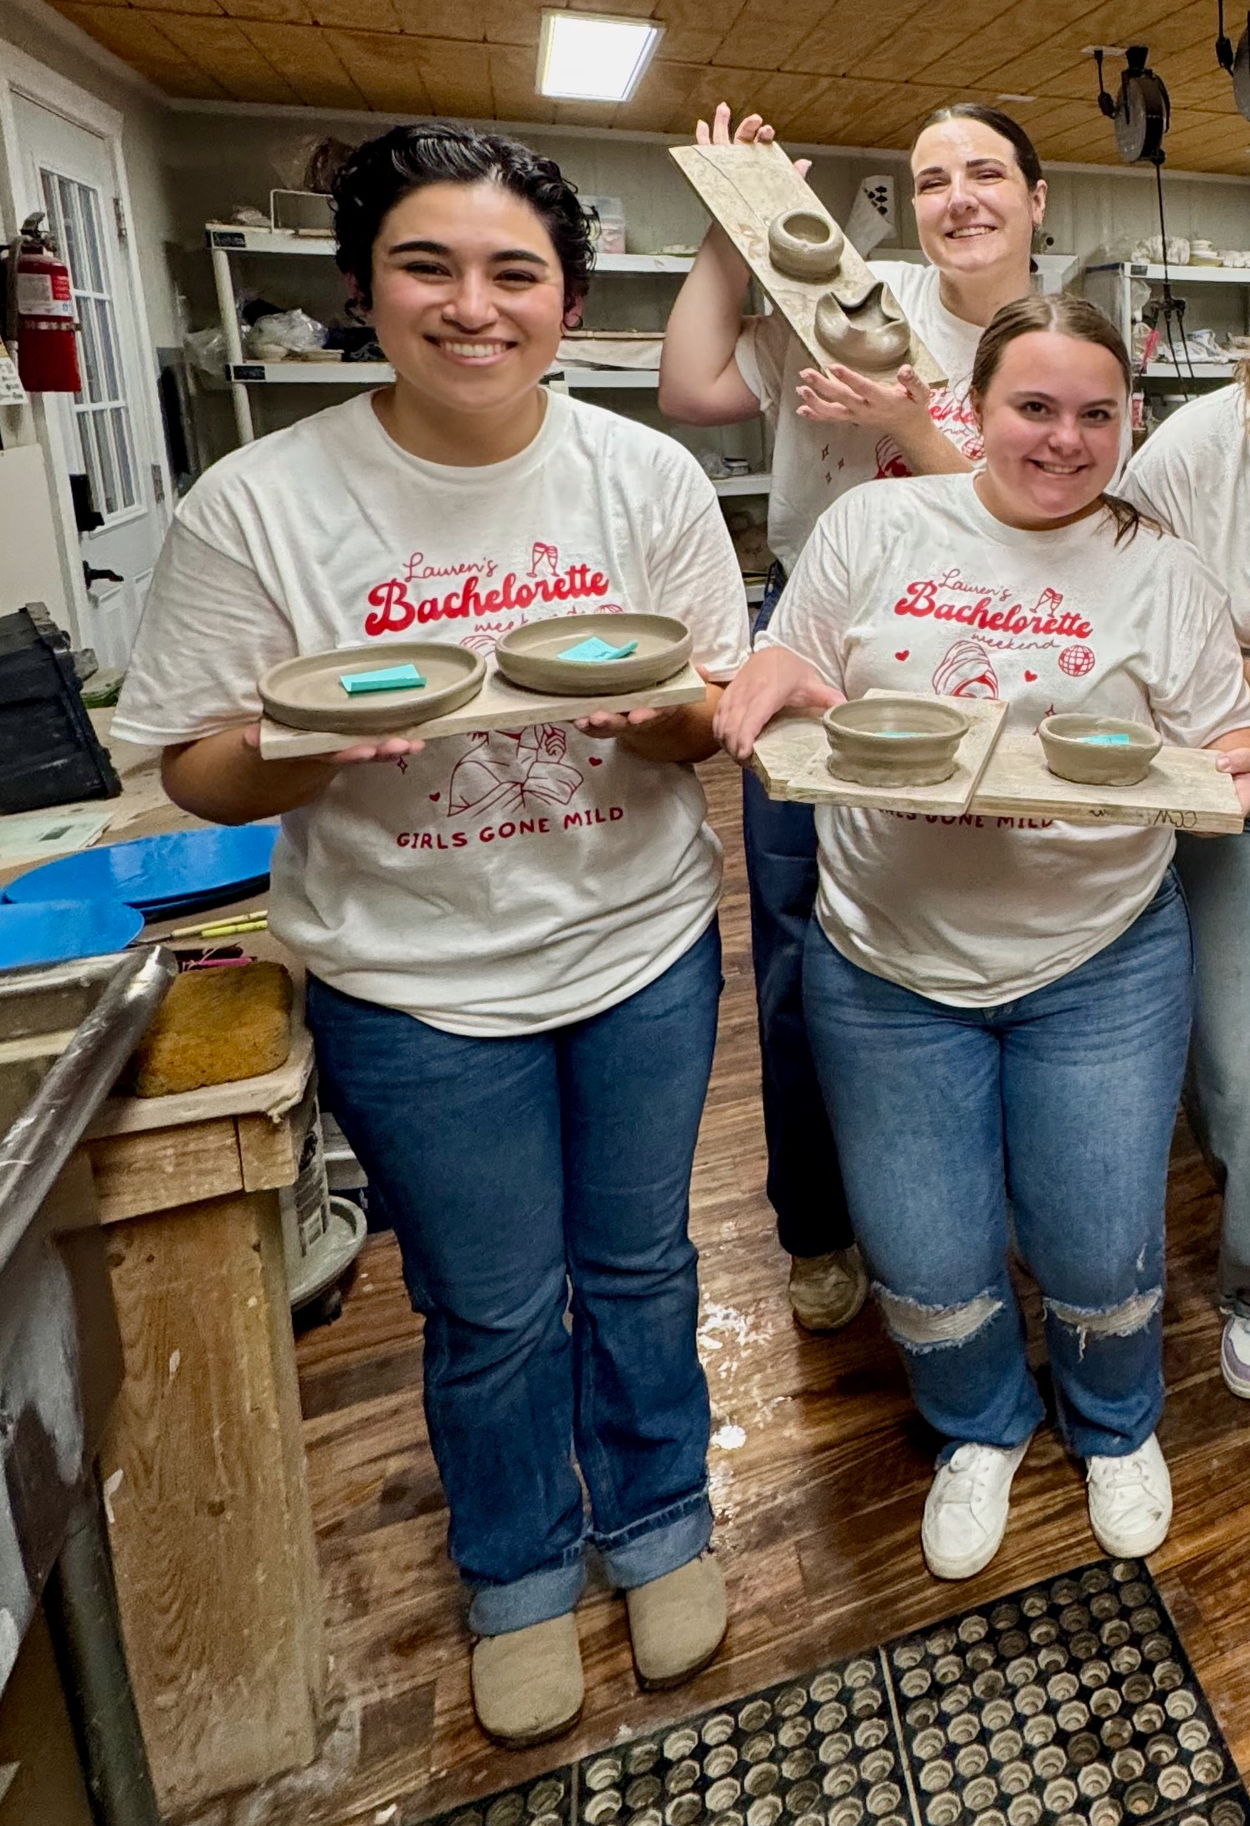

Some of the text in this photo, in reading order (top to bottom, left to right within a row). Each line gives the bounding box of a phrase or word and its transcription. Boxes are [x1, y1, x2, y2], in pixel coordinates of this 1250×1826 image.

[403, 552, 498, 582] Lauren's
[938, 568, 1012, 600] Lauren's
[365, 563, 609, 637] Bachelorette
[894, 579, 1093, 639] Bachelorette
[971, 632, 1062, 650] weekend
[396, 806, 625, 850] GIRLS GONE MILD
